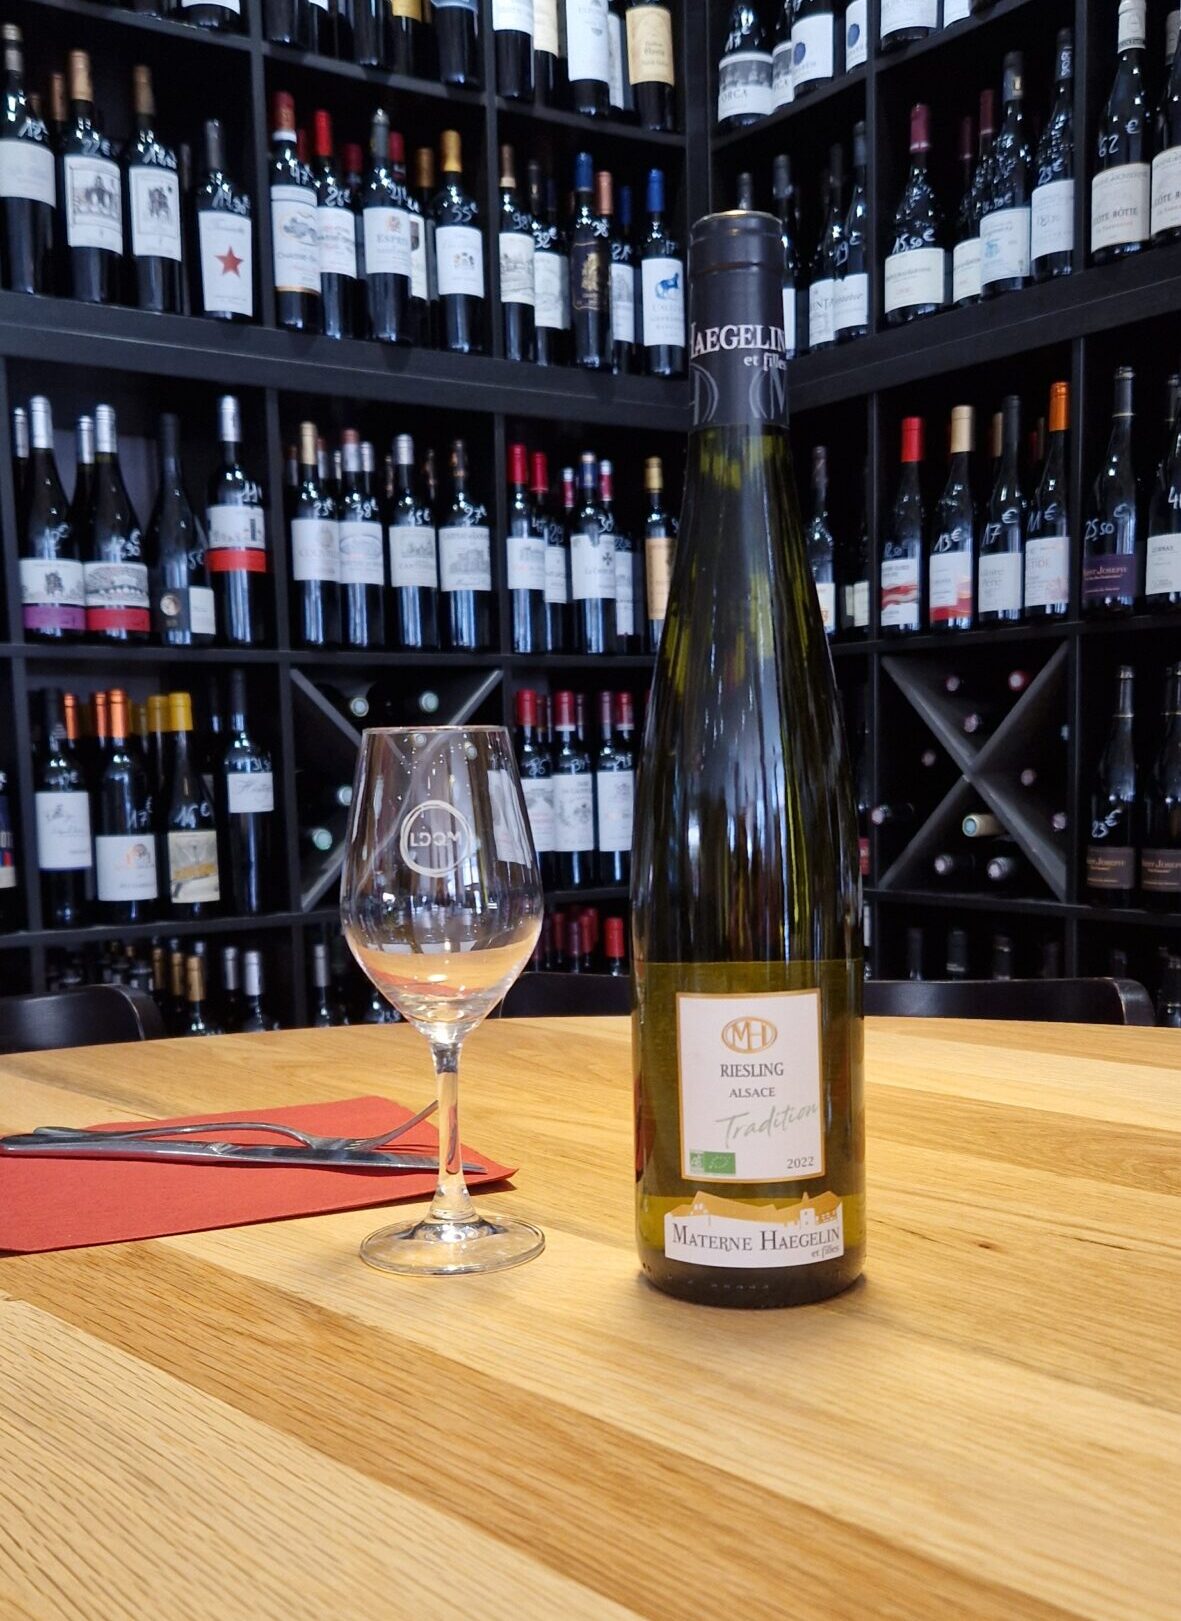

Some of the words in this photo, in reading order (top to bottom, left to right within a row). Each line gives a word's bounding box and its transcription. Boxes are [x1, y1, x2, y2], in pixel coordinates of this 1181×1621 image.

[743, 356, 759, 367] et
[720, 1062, 784, 1078] RIESLING
[729, 1087, 776, 1099] ALSACE
[714, 1103, 818, 1149] Tradition
[786, 1156, 815, 1170] 2022
[672, 1222, 753, 1252] MATERNE
[759, 1227, 840, 1252] HAEGELIN
